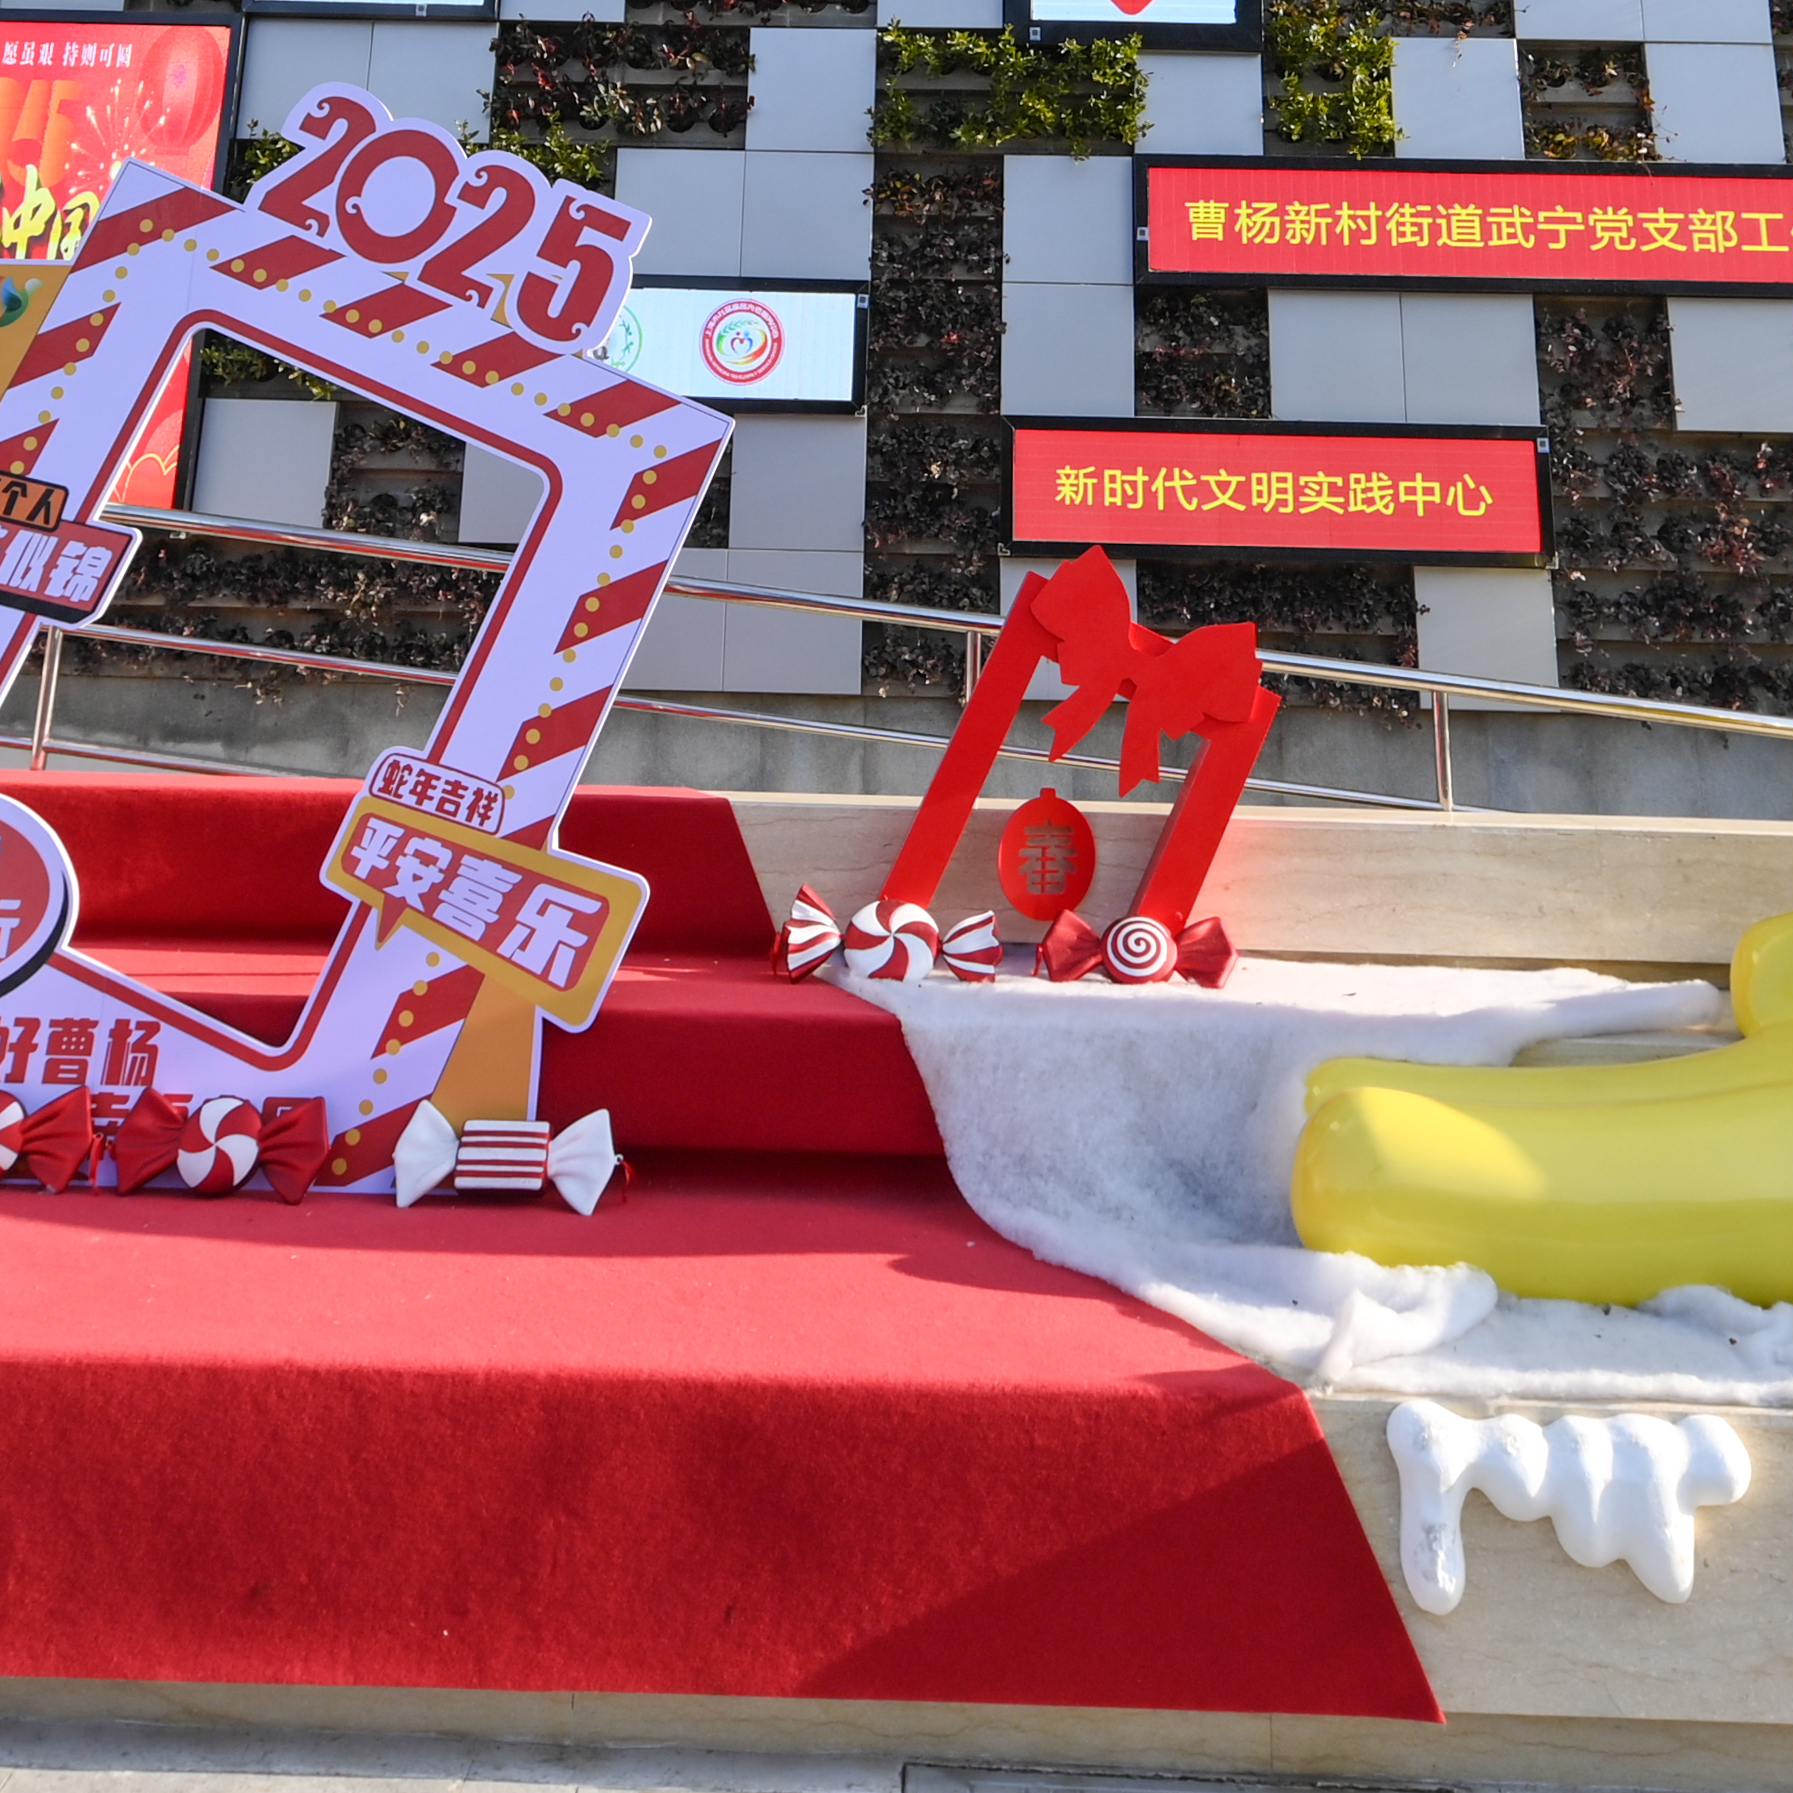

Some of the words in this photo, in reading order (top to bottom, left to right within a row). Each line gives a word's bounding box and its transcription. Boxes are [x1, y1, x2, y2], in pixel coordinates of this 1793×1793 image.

[258, 96, 632, 342] 2025
[1054, 465, 1494, 518] 新时代文明实践中心
[378, 759, 499, 827] 蛇年吉祥
[1017, 819, 1078, 896] 春
[350, 816, 603, 989] 平安喜乐
